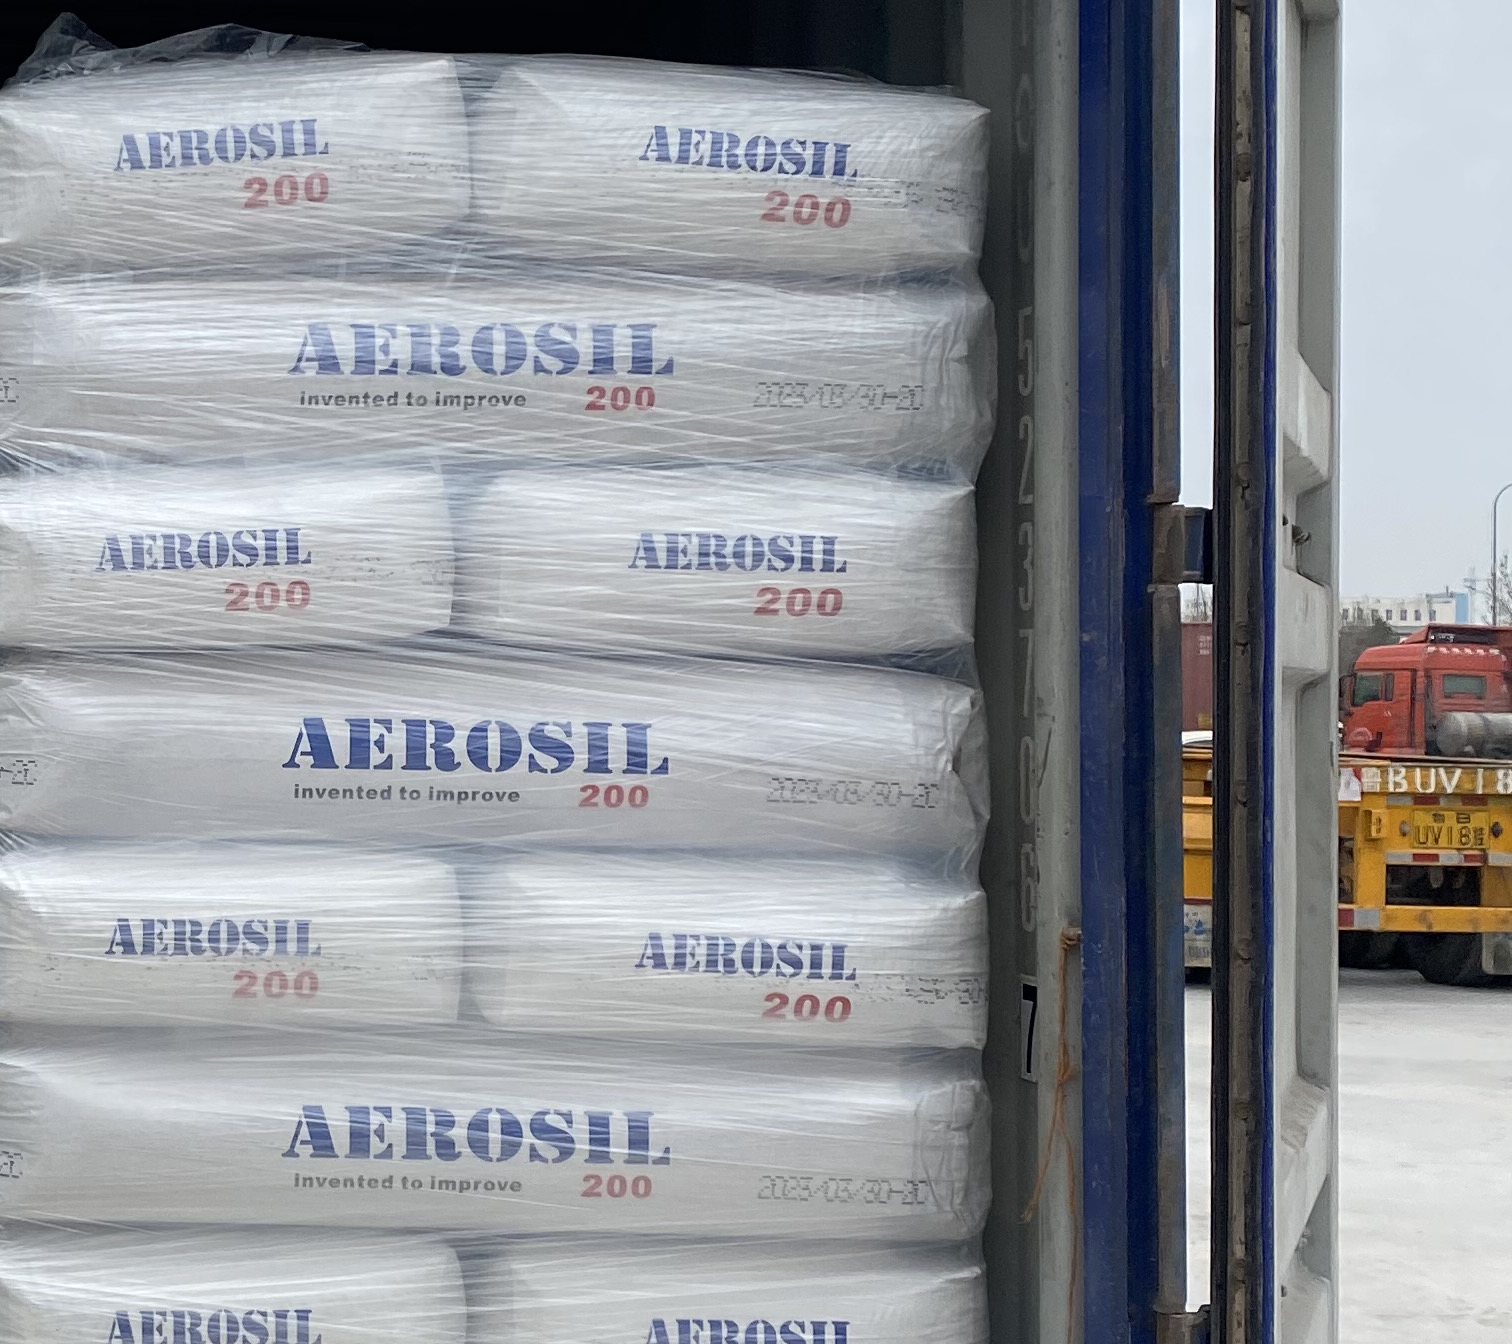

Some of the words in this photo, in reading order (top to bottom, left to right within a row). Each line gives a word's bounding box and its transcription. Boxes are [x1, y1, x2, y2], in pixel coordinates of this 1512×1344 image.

[114, 119, 329, 169] AEROSIL
[638, 125, 857, 178] AEROSIL
[243, 171, 328, 209] 200
[760, 190, 852, 229] 200
[287, 323, 675, 376] AEROSIL
[300, 391, 398, 406] invented
[406, 392, 427, 406] to
[436, 392, 526, 410] improve
[584, 384, 657, 413] 200
[95, 528, 312, 570] AEROSIL
[628, 532, 847, 572] AEROSIL
[226, 579, 310, 612] 200
[754, 586, 842, 617] 200
[282, 716, 669, 774] AEROSIL
[294, 784, 392, 800] invented
[400, 786, 421, 800] to
[429, 786, 520, 804] improve
[580, 783, 648, 808] 200
[105, 917, 321, 955] AEROSIL
[636, 933, 856, 979] AEROSIL
[232, 968, 321, 1000] 200
[765, 992, 851, 1021] 200
[281, 1105, 670, 1162] AEROSIL
[294, 1173, 393, 1189] invented
[401, 1176, 422, 1189] to
[431, 1176, 522, 1193] improve
[581, 1173, 652, 1199] 200
